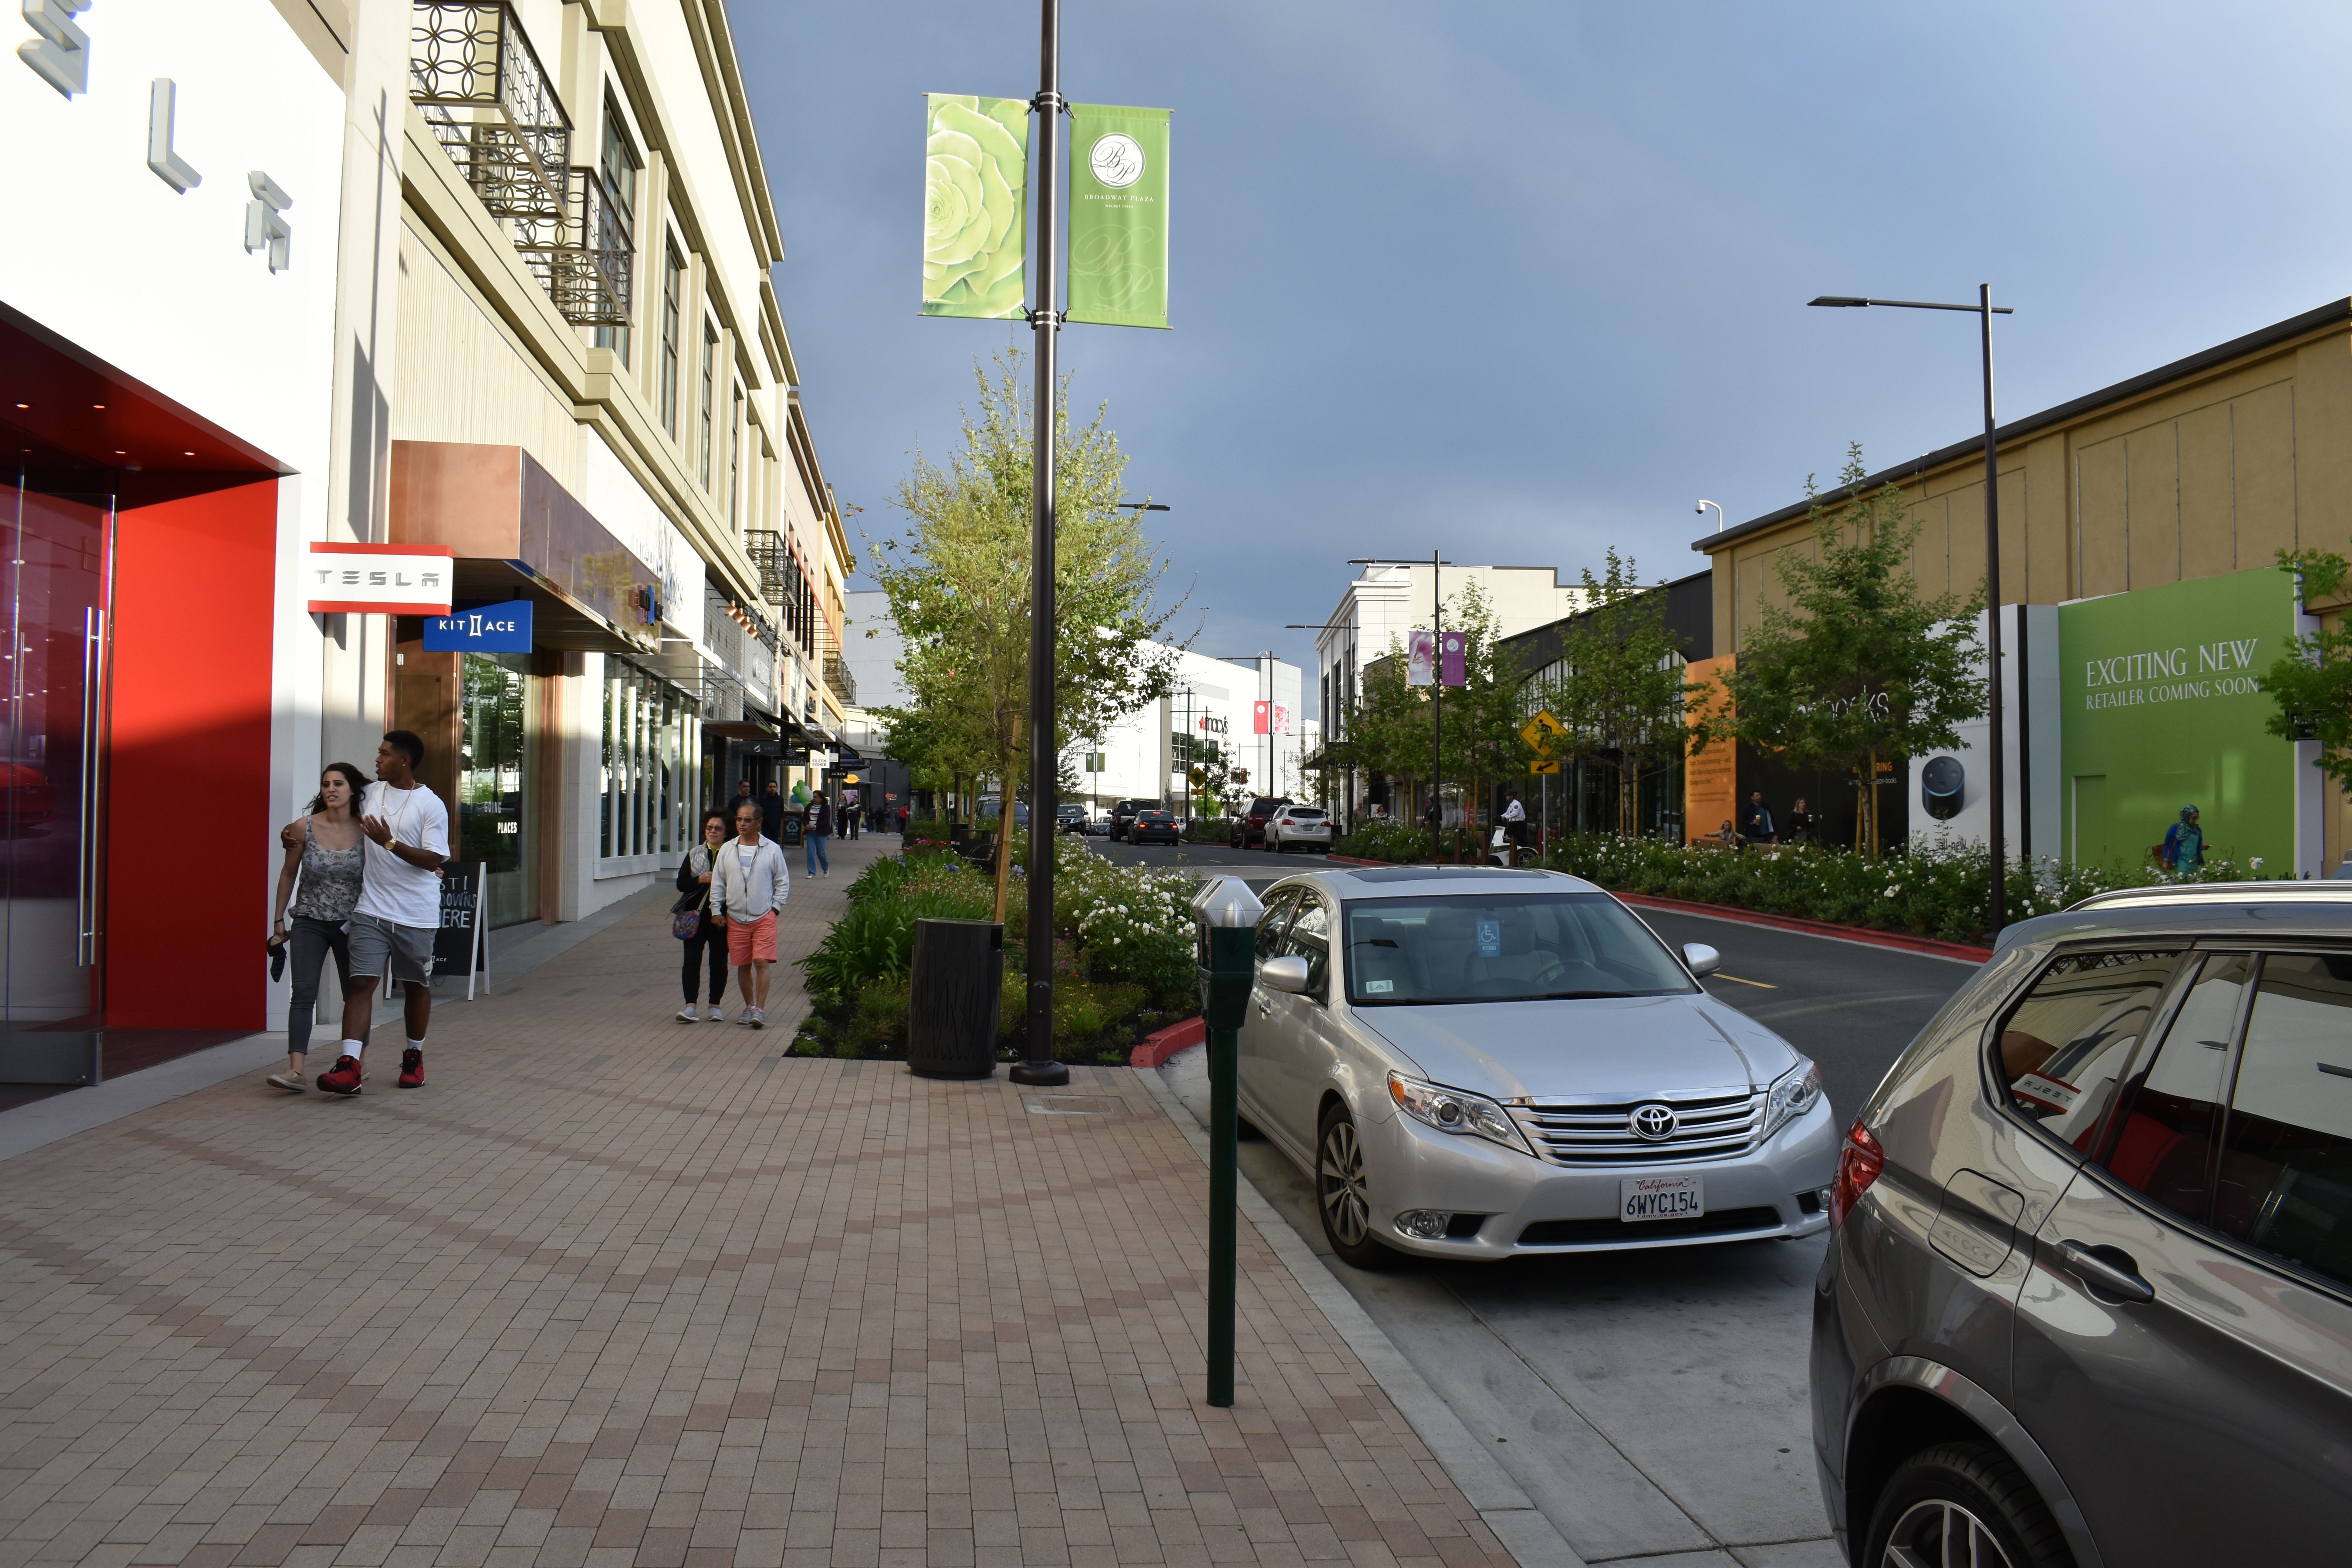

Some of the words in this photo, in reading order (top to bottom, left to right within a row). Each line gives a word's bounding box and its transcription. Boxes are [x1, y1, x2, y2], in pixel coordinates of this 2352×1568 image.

[314, 570, 439, 587] TESLA
[439, 620, 464, 631] KIT
[485, 620, 515, 632] ACE
[2086, 647, 2187, 688] EXCITING
[2199, 638, 2259, 672] NEW
[2086, 688, 2145, 710] RETAILER
[2149, 679, 2210, 703] COMING
[2215, 676, 2259, 697] SOON
[484, 801, 502, 814] GOING
[497, 821, 517, 834] PLACES
[1639, 1179, 1689, 1193] California
[1626, 1191, 1699, 1215] 6WYC154
